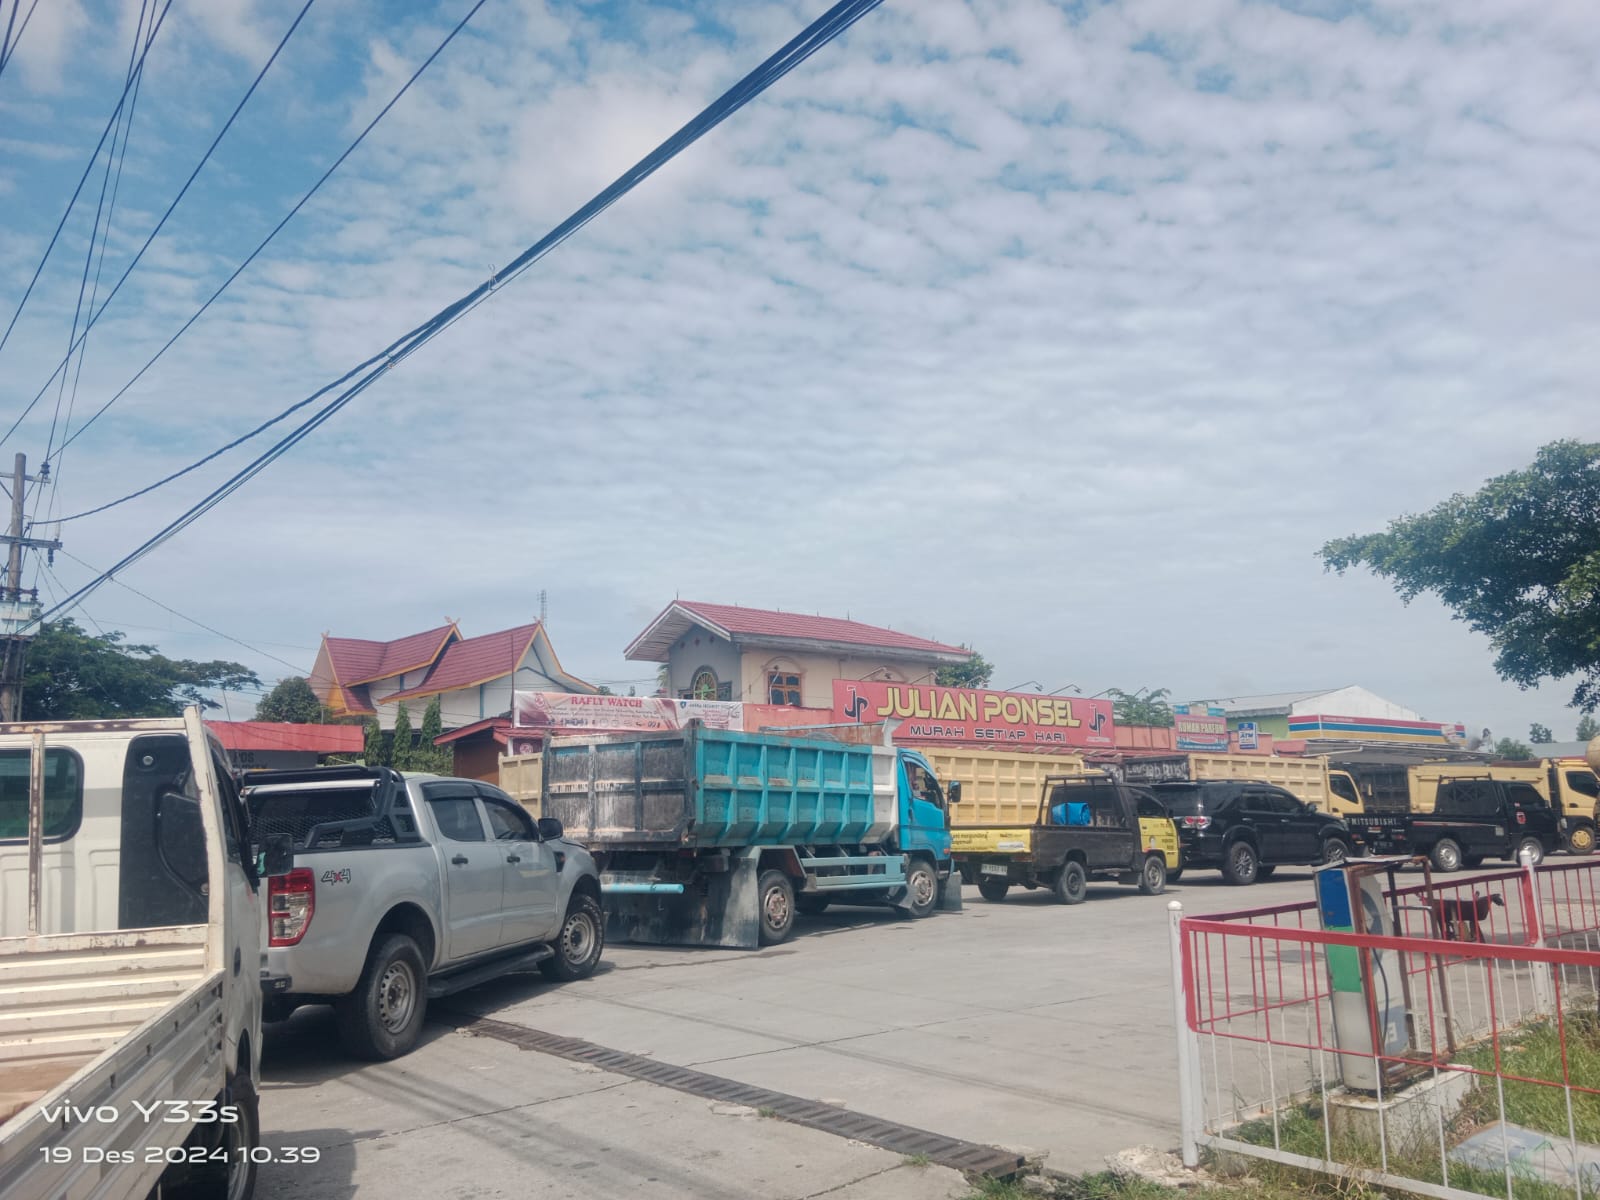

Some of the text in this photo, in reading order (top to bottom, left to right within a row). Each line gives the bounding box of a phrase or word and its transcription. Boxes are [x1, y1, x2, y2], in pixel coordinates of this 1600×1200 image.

[571, 696, 642, 708] RAFLY WATCH
[877, 686, 1081, 728] JULIAN PONSEL
[910, 725, 1066, 743] MURAH SETIAP HARI
[1351, 817, 1397, 826] MITSUBISHI
